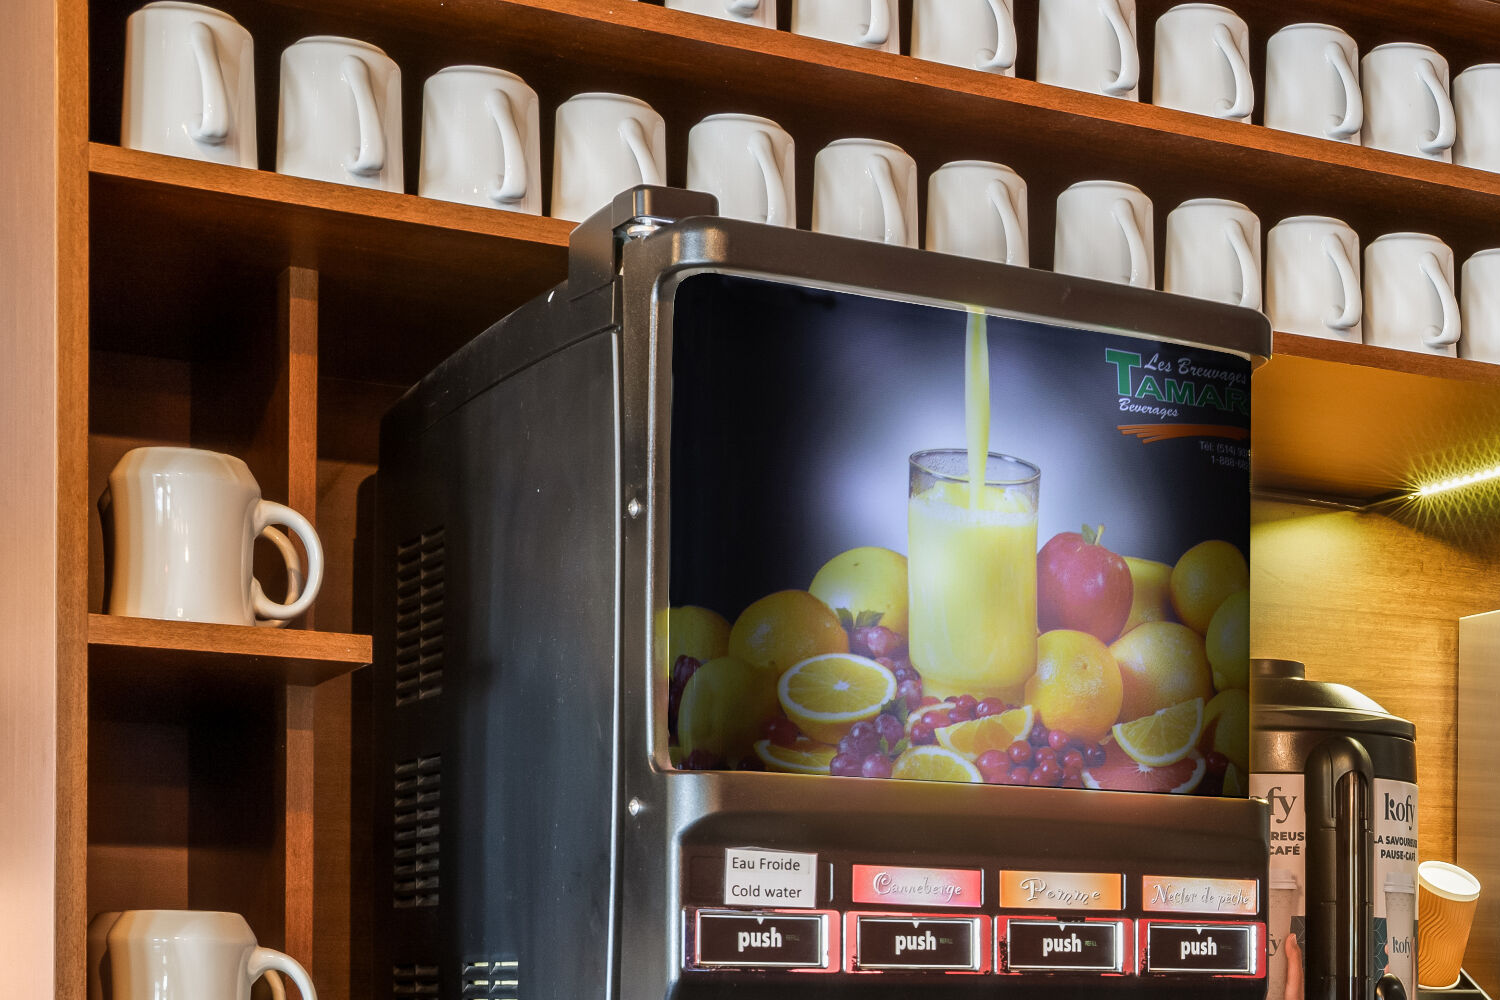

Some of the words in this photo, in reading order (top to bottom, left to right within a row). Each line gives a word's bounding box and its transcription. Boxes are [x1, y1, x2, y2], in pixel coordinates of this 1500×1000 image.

[1144, 353, 1172, 373] Les
[1178, 358, 1246, 386] Breuvages
[1118, 398, 1180, 420] Beverages
[1384, 792, 1415, 830] kofy
[732, 857, 755, 870] Eau
[759, 857, 801, 871] Froide
[731, 884, 760, 898] Cold
[764, 886, 802, 898] water
[873, 871, 963, 903] Canneberge
[1020, 878, 1101, 906] Pomme
[738, 927, 782, 952] push
[895, 931, 936, 955] push
[1043, 933, 1082, 957] push
[1181, 937, 1217, 960] push
[1392, 936, 1412, 958] kofy
